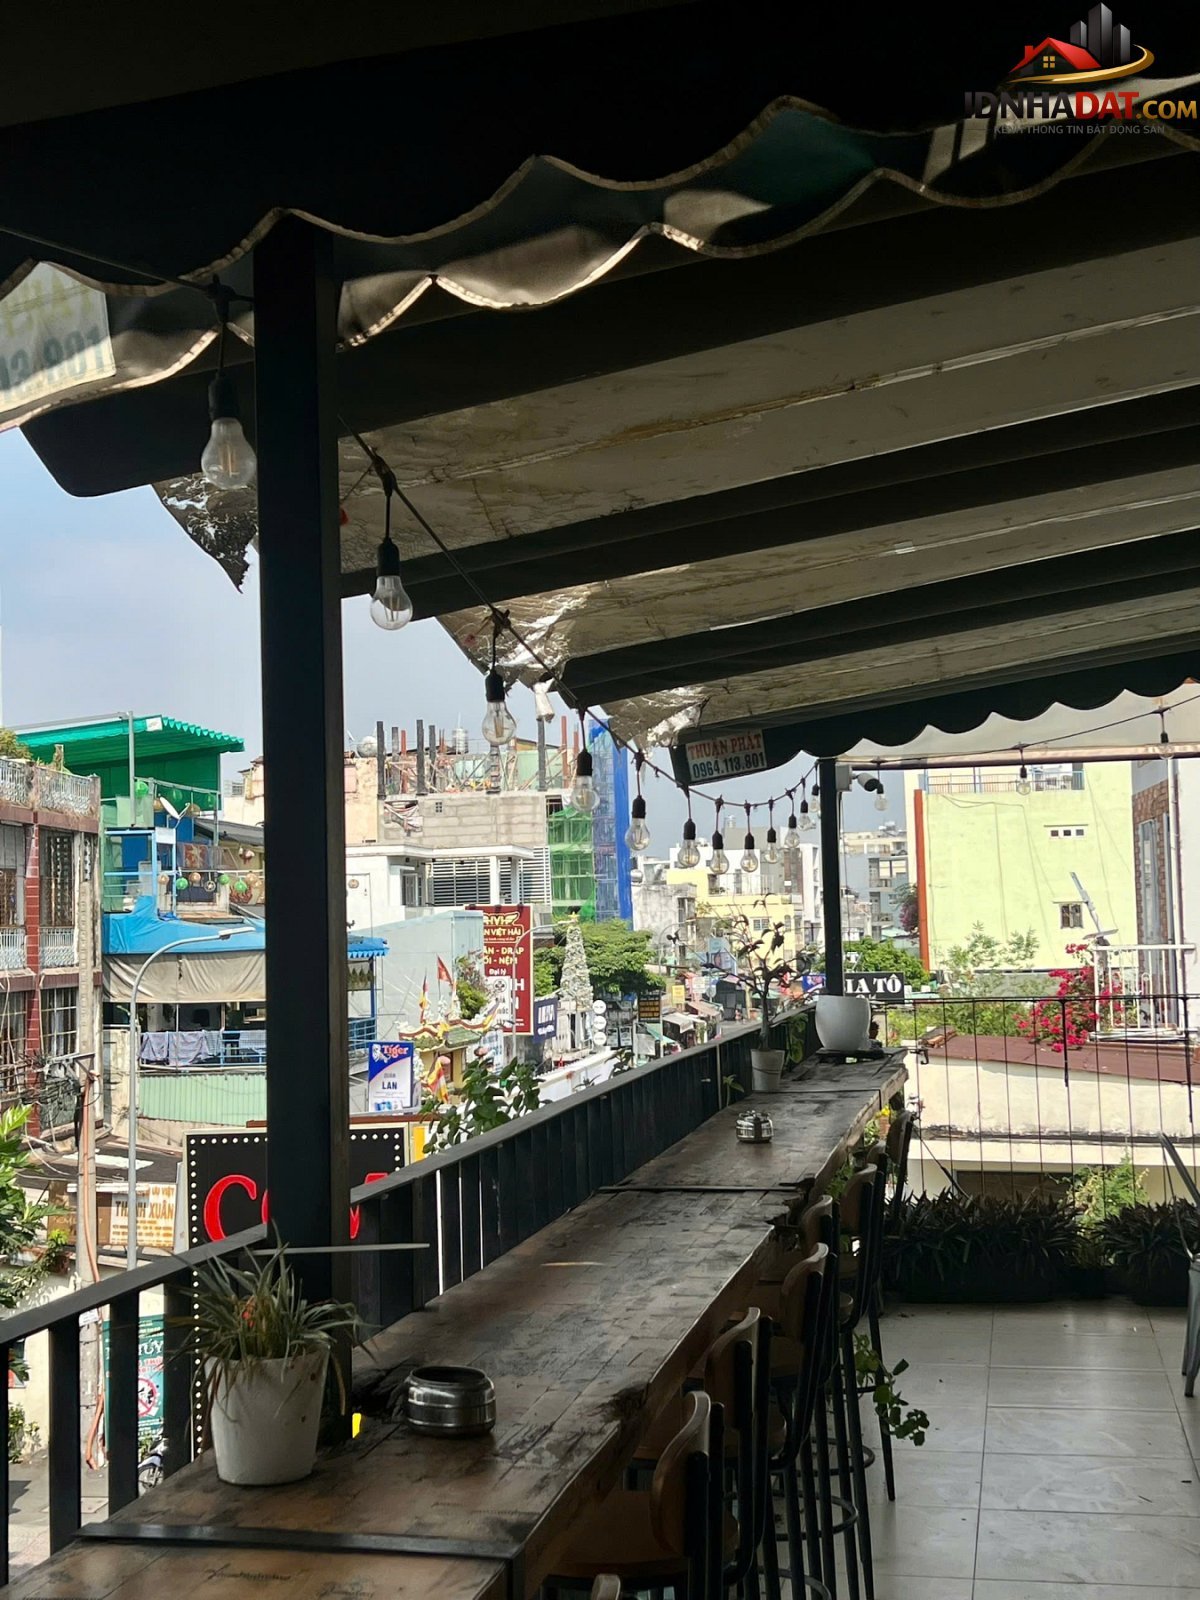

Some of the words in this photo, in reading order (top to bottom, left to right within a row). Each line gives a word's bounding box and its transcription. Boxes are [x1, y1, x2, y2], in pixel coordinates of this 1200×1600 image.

[692, 751, 766, 779] 0964.113.801
[873, 973, 902, 994] TÔ
[382, 1044, 409, 1058] Tiger
[382, 1081, 398, 1090] LAN
[148, 1199, 174, 1219] XUÂN
